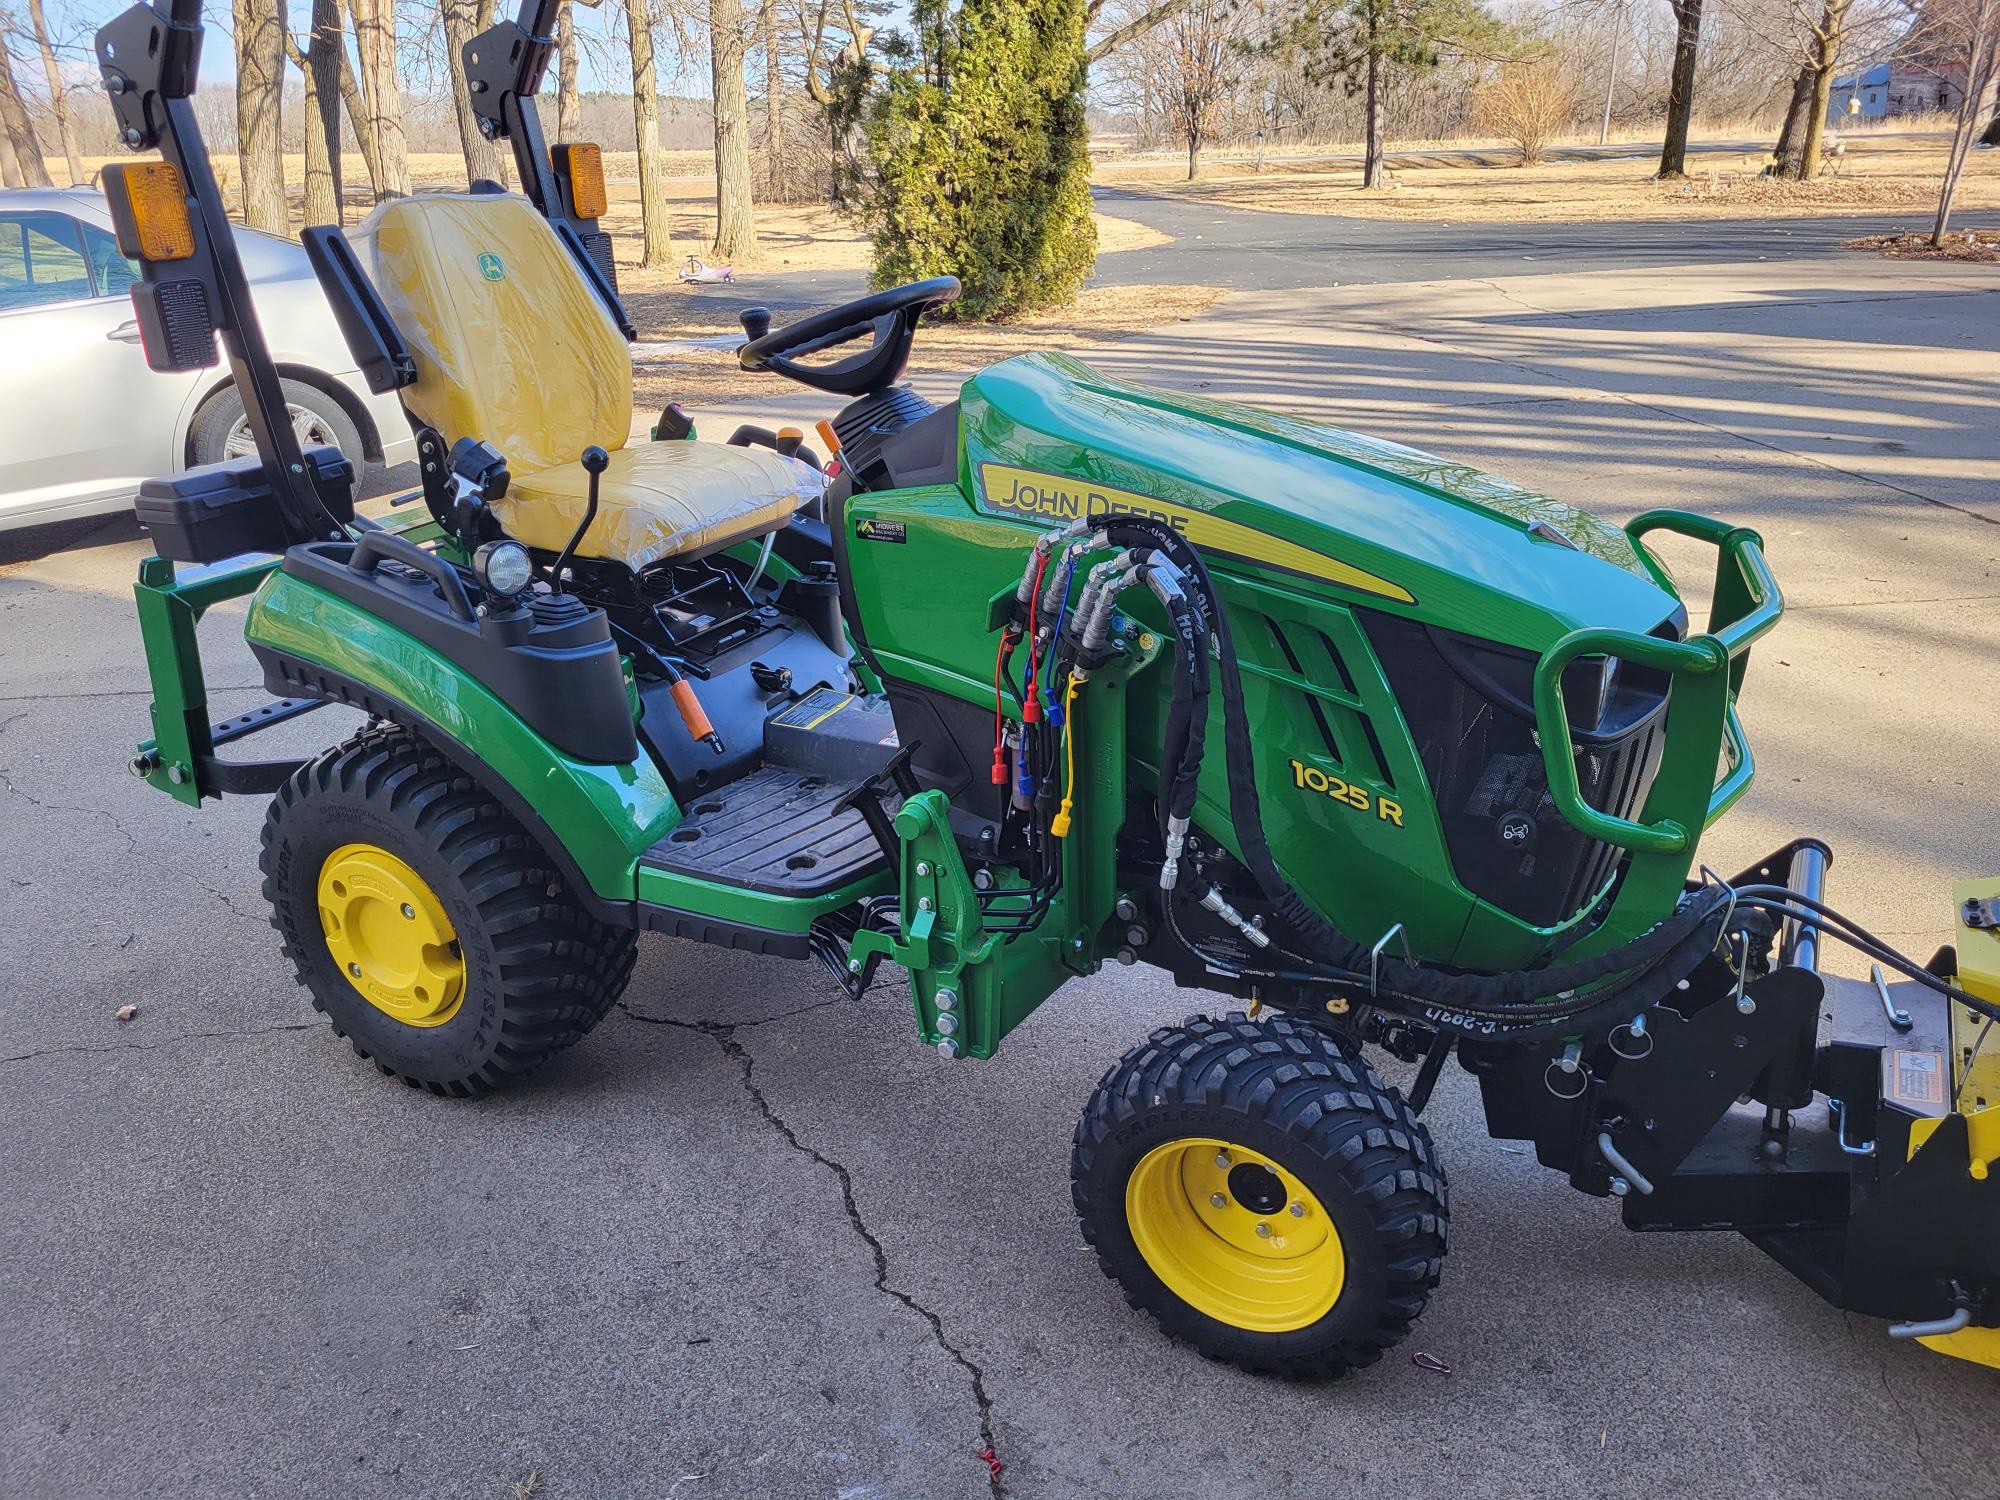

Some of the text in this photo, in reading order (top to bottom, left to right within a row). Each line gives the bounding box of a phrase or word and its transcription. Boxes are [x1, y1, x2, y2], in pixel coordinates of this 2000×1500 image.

[1002, 479, 1079, 516] JOHN
[875, 522, 905, 532] MIDWEST
[1290, 759, 1405, 828] 1025 R
[452, 897, 497, 1052] CARLISLE
